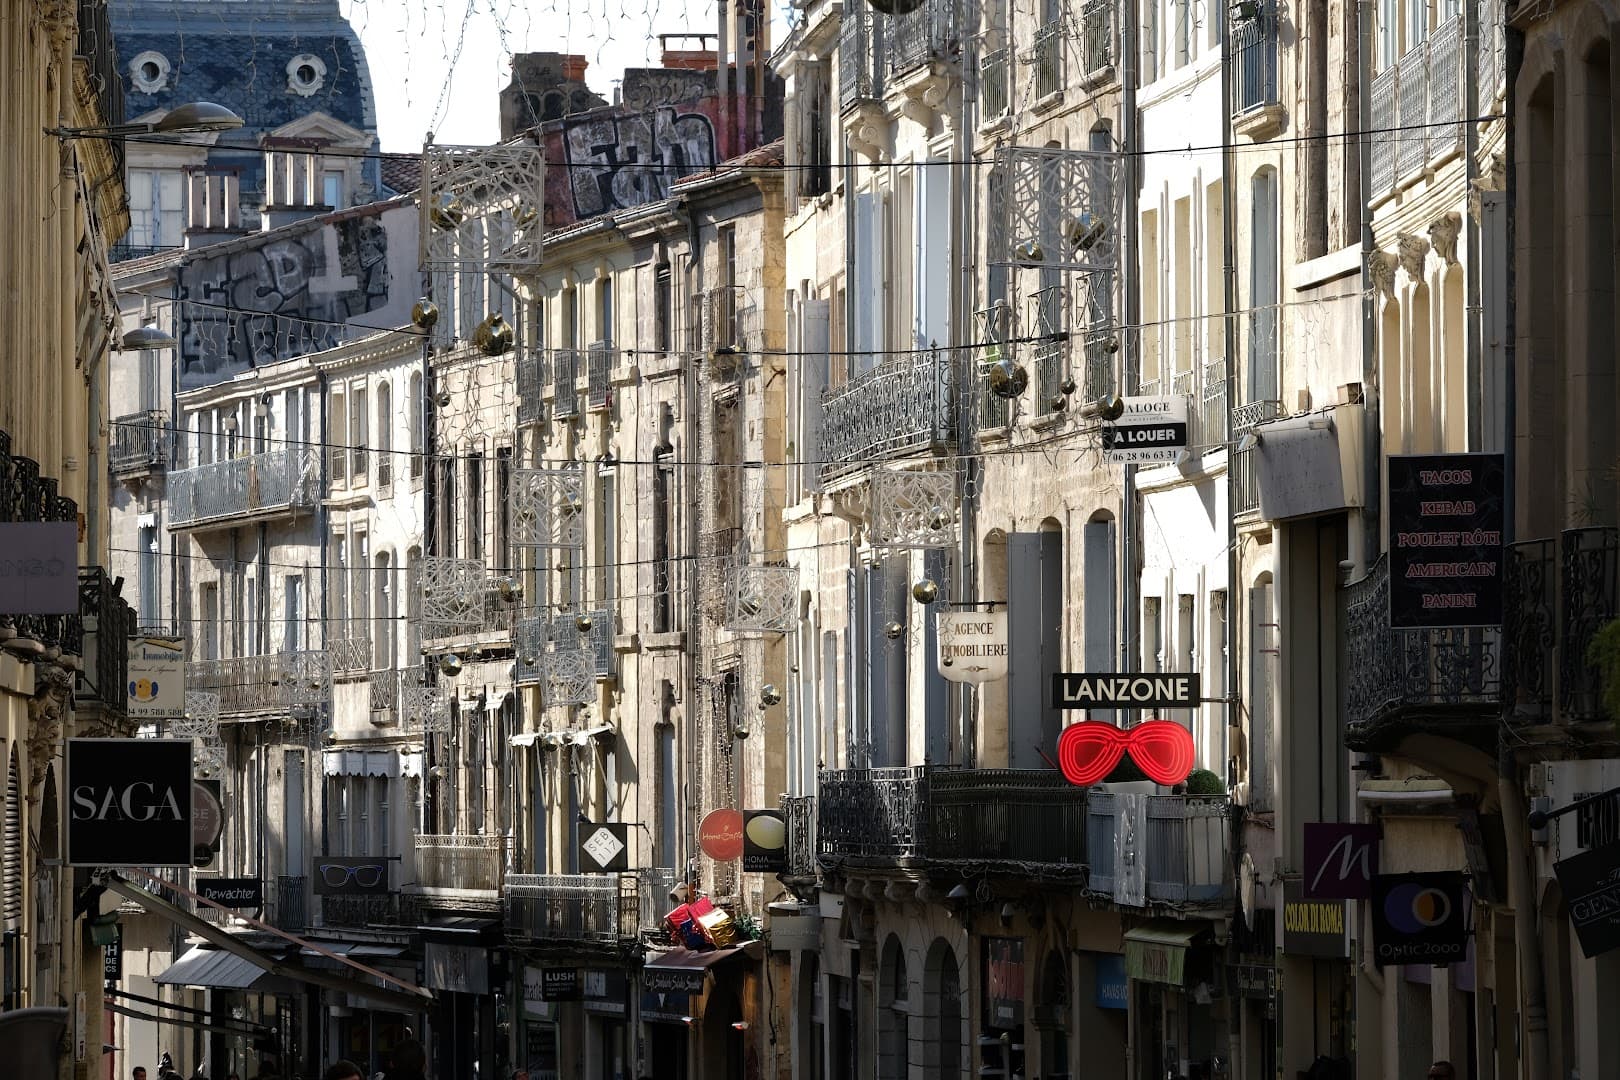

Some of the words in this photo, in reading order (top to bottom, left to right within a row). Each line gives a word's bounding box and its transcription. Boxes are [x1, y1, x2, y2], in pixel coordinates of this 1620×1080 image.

[1114, 432, 1125, 443] A
[1128, 429, 1176, 442] LOUER
[1113, 453, 1124, 461] 06
[1127, 452, 1137, 461] 28
[1140, 452, 1151, 460] 96
[1153, 451, 1164, 459] 63
[1167, 450, 1176, 459] 31
[1420, 470, 1472, 485] TACOS
[1420, 501, 1476, 516] KEBAB
[1398, 532, 1460, 547] POULET
[1461, 528, 1500, 546] RÔTI
[1405, 562, 1496, 578] AMERICAIN
[1422, 593, 1477, 609] PANINI
[954, 622, 994, 635] AGENCE
[1063, 678, 1189, 701] LANZONE
[73, 782, 184, 822] SAGA
[589, 832, 608, 851] SEB
[205, 888, 256, 900] Dewachter
[1285, 903, 1309, 932] COLOR
[1311, 903, 1318, 932] DI
[1320, 904, 1344, 934] ROMA
[1378, 942, 1423, 960] Optic
[1424, 942, 1461, 954] 2000
[546, 972, 576, 982] LUSH
